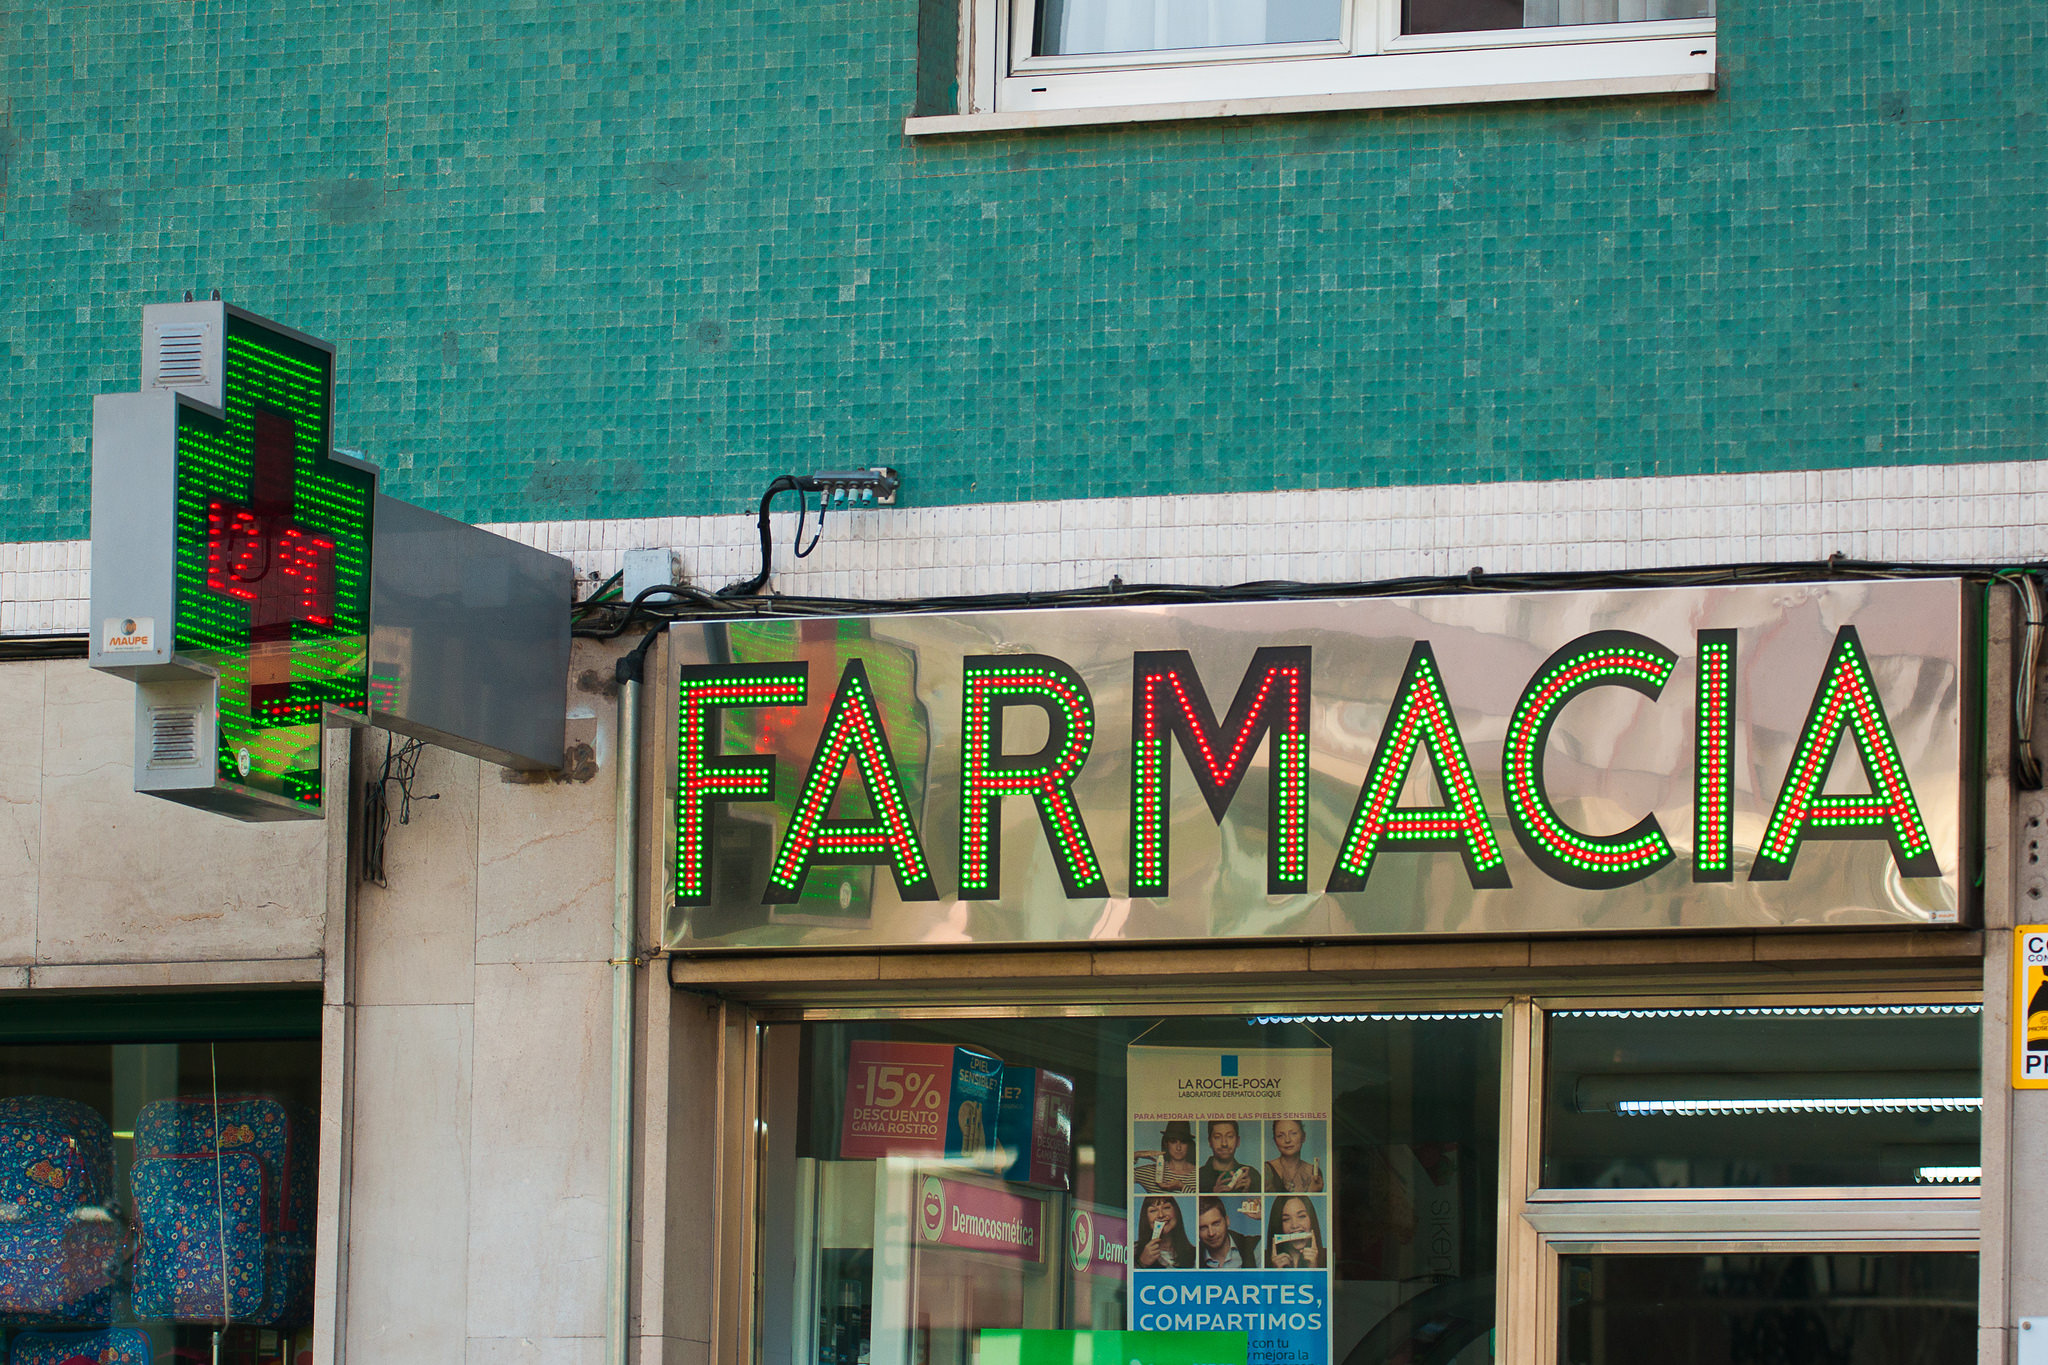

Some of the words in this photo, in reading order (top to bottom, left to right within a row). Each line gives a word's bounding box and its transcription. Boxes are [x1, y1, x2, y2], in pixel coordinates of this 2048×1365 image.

[109, 635, 149, 646] MAUPE
[674, 622, 1943, 907] FARMACIA
[2028, 936, 2048, 954] C
[855, 1065, 941, 1110] -15%
[1178, 1079, 1194, 1090] LA
[1196, 1078, 1281, 1089] ROCHE-POSAY
[1178, 1090, 1221, 1098] LABORATOIRE
[1222, 1090, 1281, 1098] DERMATOLOGIQUE
[853, 1108, 939, 1124] DESCUENTO
[851, 1120, 886, 1133] GAMA
[887, 1122, 938, 1136] ROSTRO
[952, 1205, 1034, 1247] Dermocosmética
[1139, 1284, 1322, 1309] COMPARTES,
[1139, 1313, 1322, 1331] COMPARTIMOS
[1252, 1339, 1274, 1349] con
[1277, 1338, 1289, 1349] tu
[1253, 1349, 1295, 1362] mejora
[1298, 1349, 1309, 1360] la
